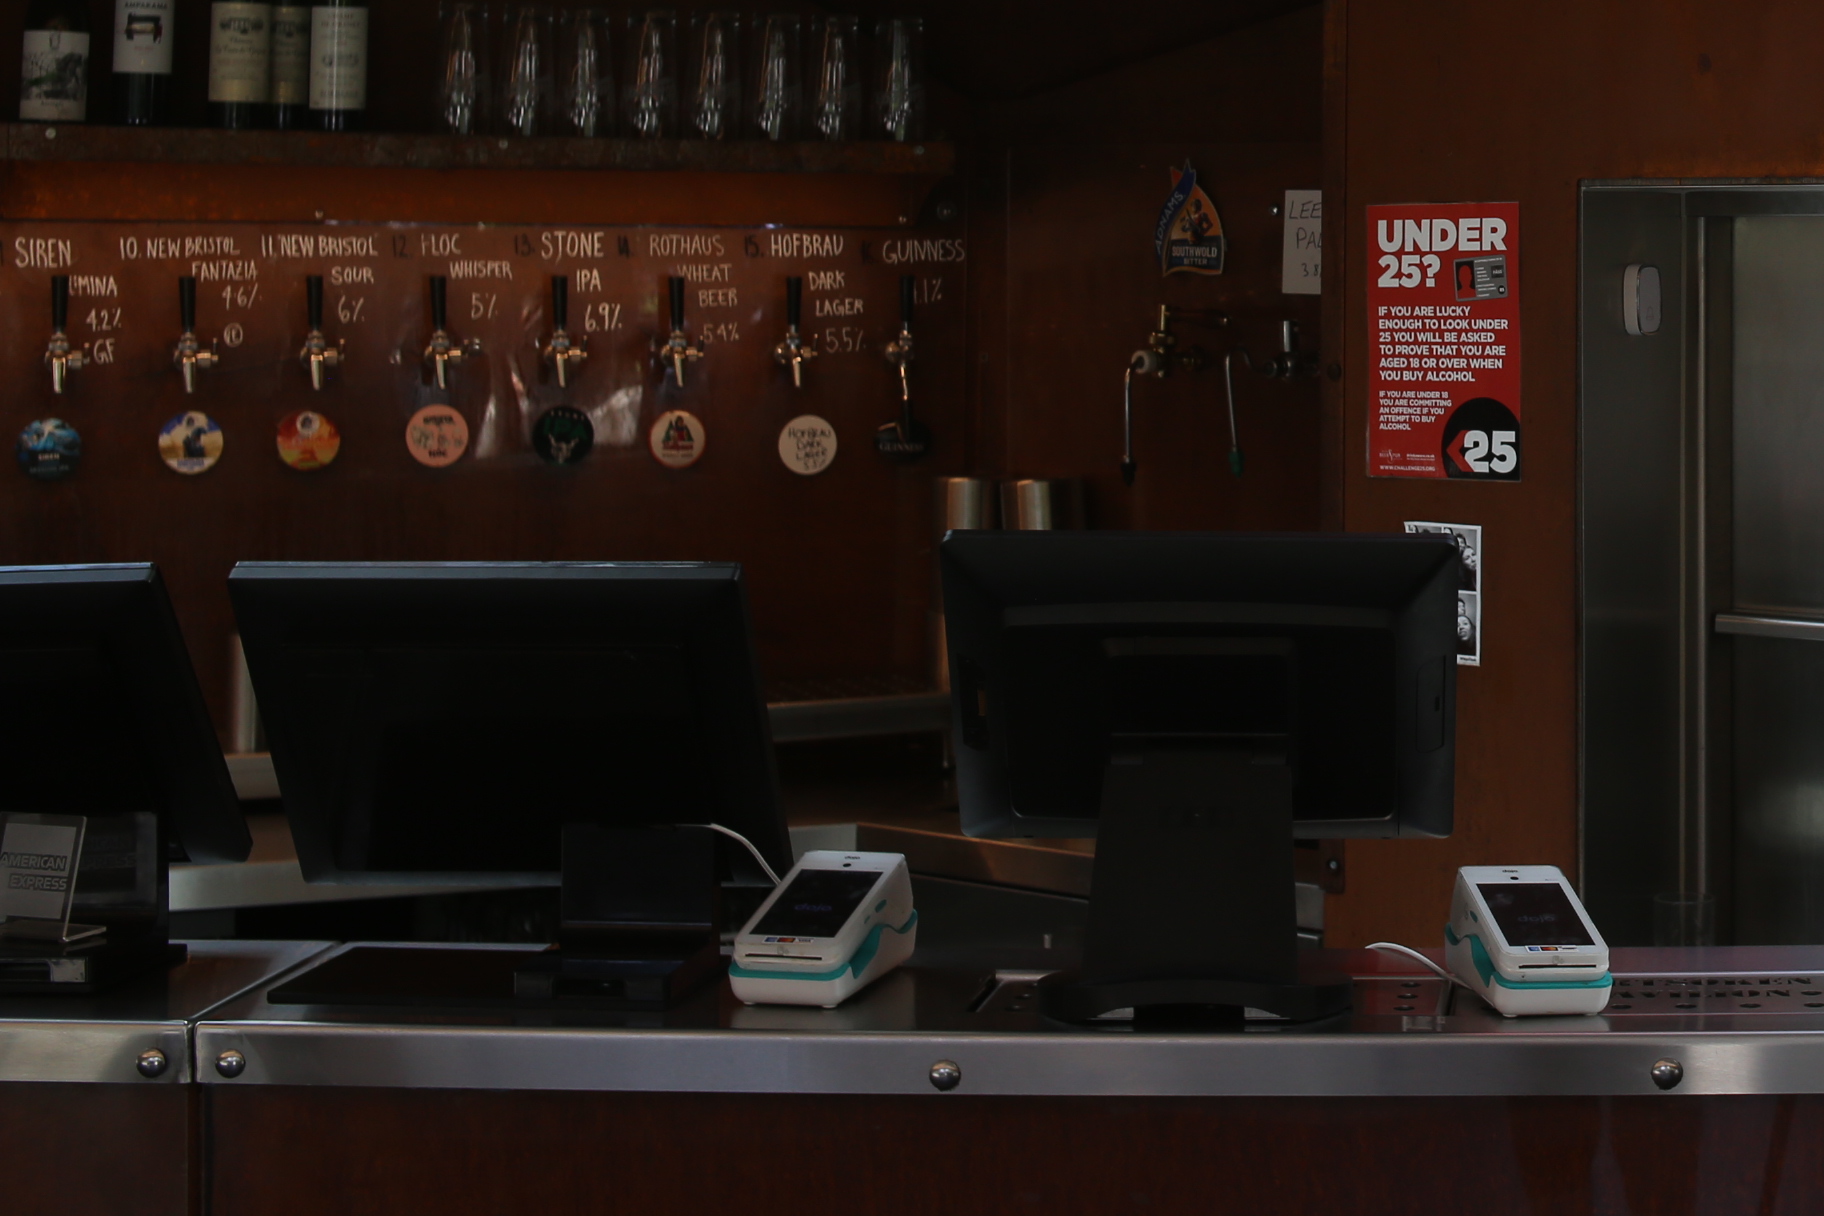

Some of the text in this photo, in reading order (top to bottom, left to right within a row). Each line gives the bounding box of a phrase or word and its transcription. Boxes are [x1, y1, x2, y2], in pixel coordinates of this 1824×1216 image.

[1155, 191, 1184, 255] ADNAMS
[650, 234, 724, 257] ROTHAUS
[1378, 218, 1507, 252] UNDER
[15, 236, 72, 268] SIREN
[147, 236, 240, 259] NEW BRISTOL
[541, 231, 604, 265] STONE
[771, 233, 843, 259] HOFBRAU
[882, 239, 965, 265] GUINNESS
[1172, 245, 1217, 257] SOUTHWOLD
[192, 259, 258, 282] FANTAZIA
[331, 266, 374, 285] SOUR
[450, 259, 513, 280] WHISPER
[677, 264, 732, 282] WHEAT
[1378, 254, 1441, 288] 25?
[576, 269, 601, 293] IPA
[809, 270, 845, 291] DARK
[698, 288, 738, 307] BEER
[816, 298, 864, 317] LAGER
[1378, 306, 1470, 316] IF YOU ARE LUCKY
[1379, 319, 1508, 329] ENOUGH TO LOOK UNDER
[1379, 332, 1495, 342] 25 YOU WILL BE ASKED
[1379, 345, 1506, 356] TO PROVE THAT YOU ARE
[1379, 358, 1503, 369] AGED 18 OR OVER WHEN
[1379, 371, 1475, 381] YOU BUY ALCOHOL
[1464, 430, 1517, 473] 25
[0, 853, 66, 871] AMERICAN
[9, 874, 68, 891] EXPRESS
